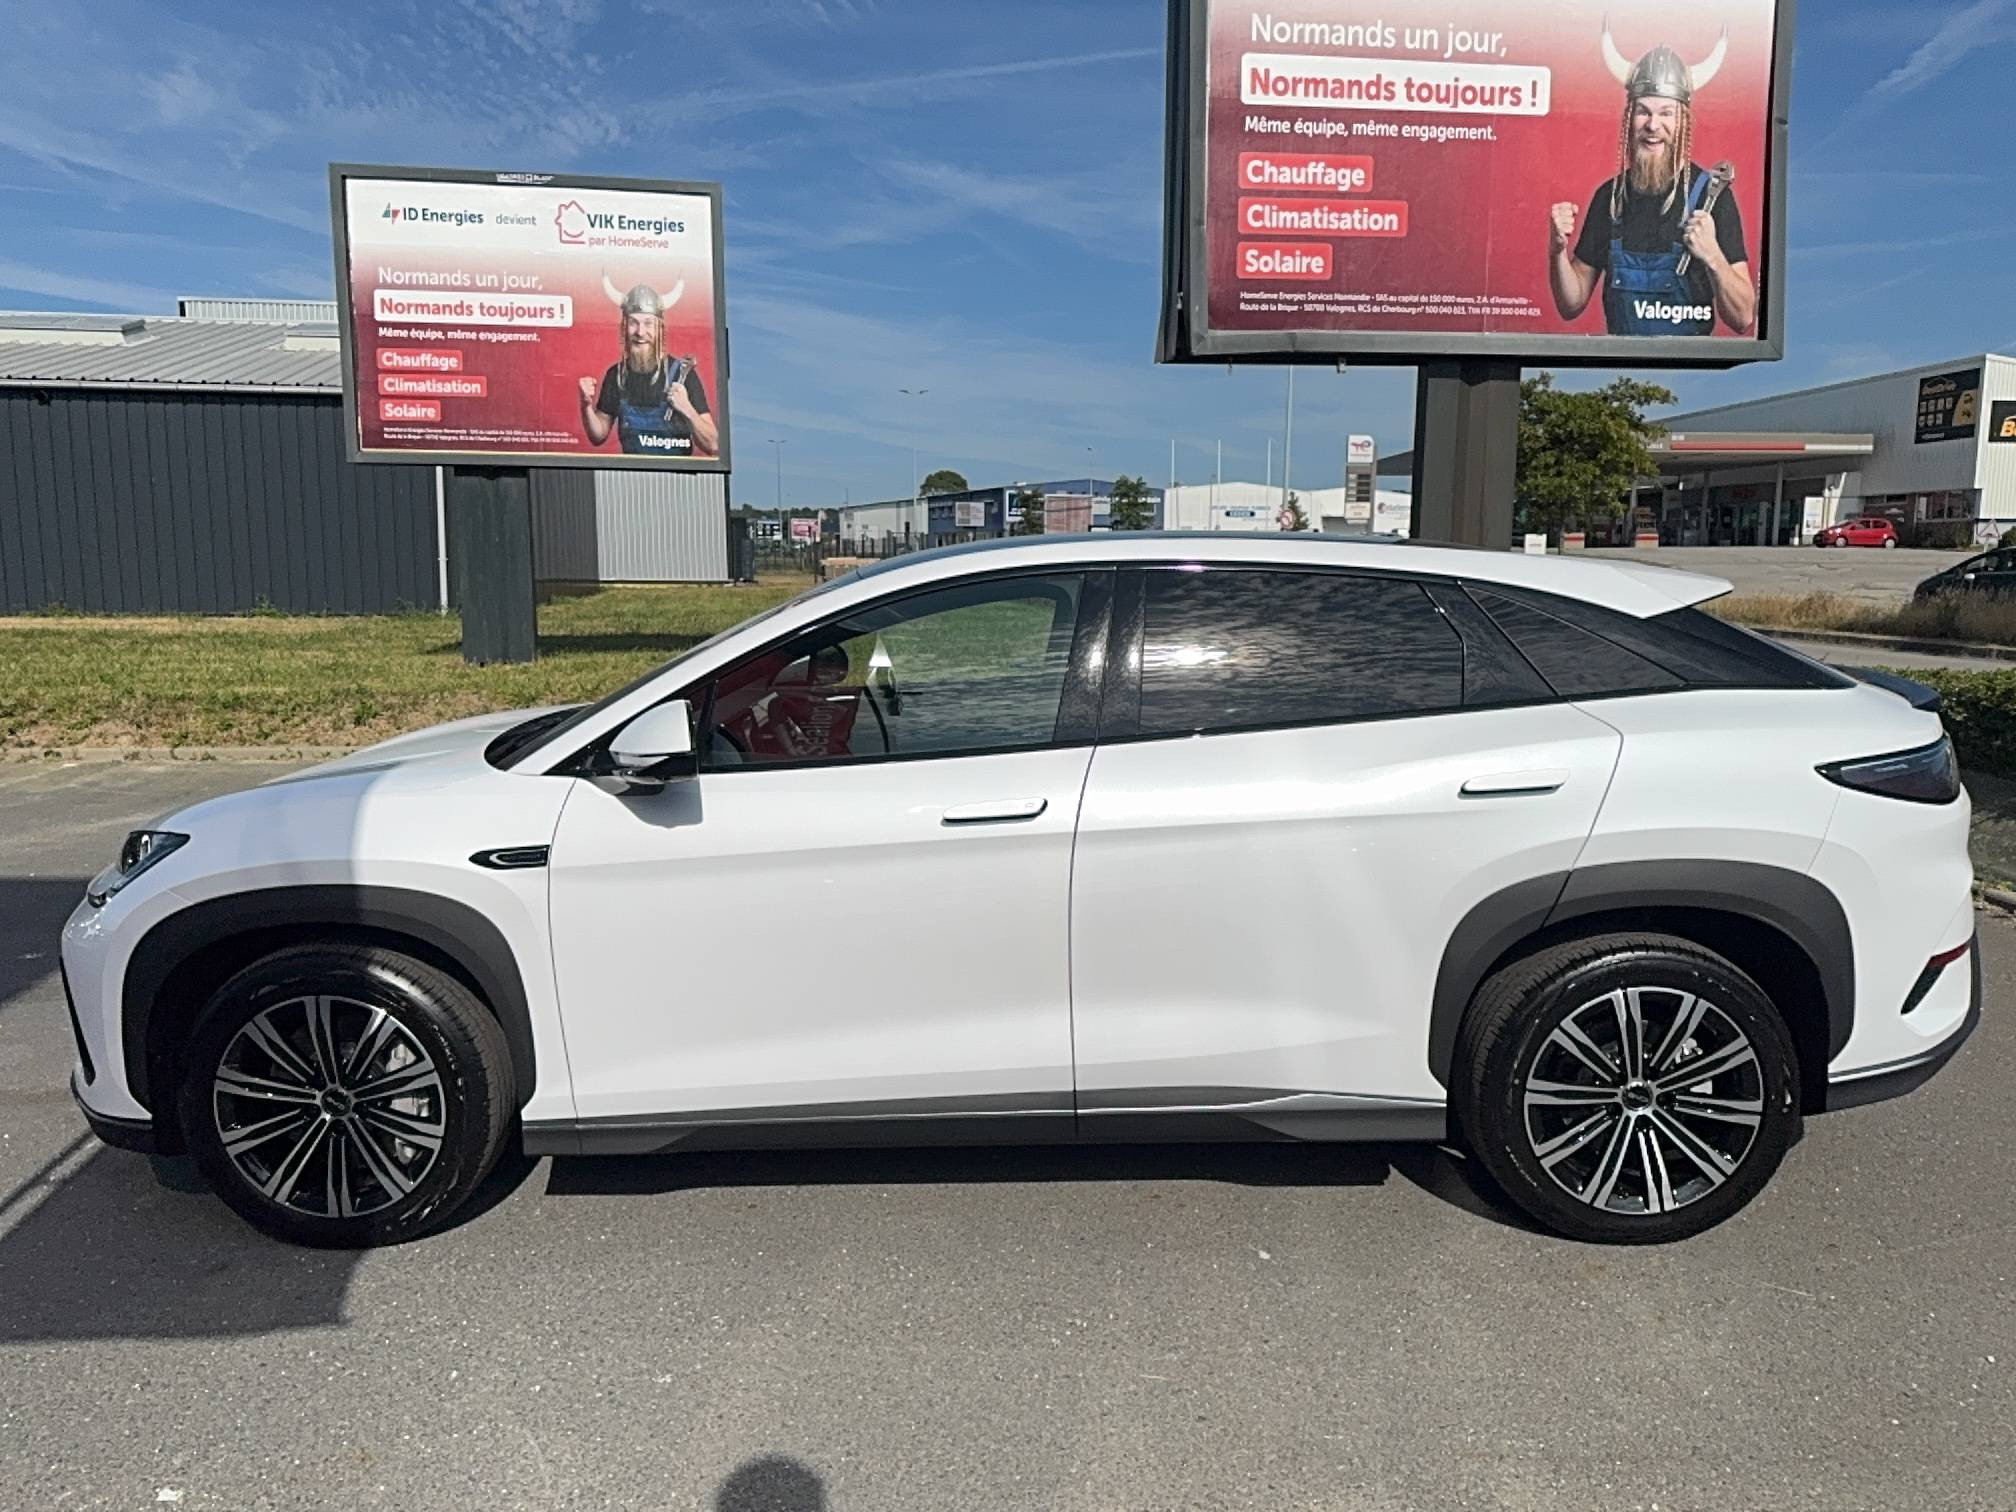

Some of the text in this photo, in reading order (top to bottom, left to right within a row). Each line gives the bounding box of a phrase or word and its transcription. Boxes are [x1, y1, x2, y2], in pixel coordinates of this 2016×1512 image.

[1251, 13, 1507, 58] Normands un jour,
[1250, 68, 1396, 101] Normands
[1404, 77, 1522, 109] toujours
[1245, 115, 1497, 142] Même équipe, même engagement.
[1246, 160, 1365, 191] Chauffage
[403, 207, 537, 226] ID Energies devient
[586, 213, 685, 235] VIK Energies
[1246, 204, 1399, 231] Climatisation
[588, 235, 669, 249] par HomeServe
[1245, 248, 1325, 273] Solaire
[378, 266, 544, 291] Normands un jour,
[380, 297, 474, 317] Normands
[479, 302, 555, 322] toujours
[1633, 300, 1712, 324] Valognes
[378, 327, 541, 343] Même équipe, même engagement.
[381, 351, 459, 371] Chauffage
[383, 377, 481, 394] Climatisation
[384, 403, 436, 418] Solaire
[638, 434, 691, 450] Valognes
